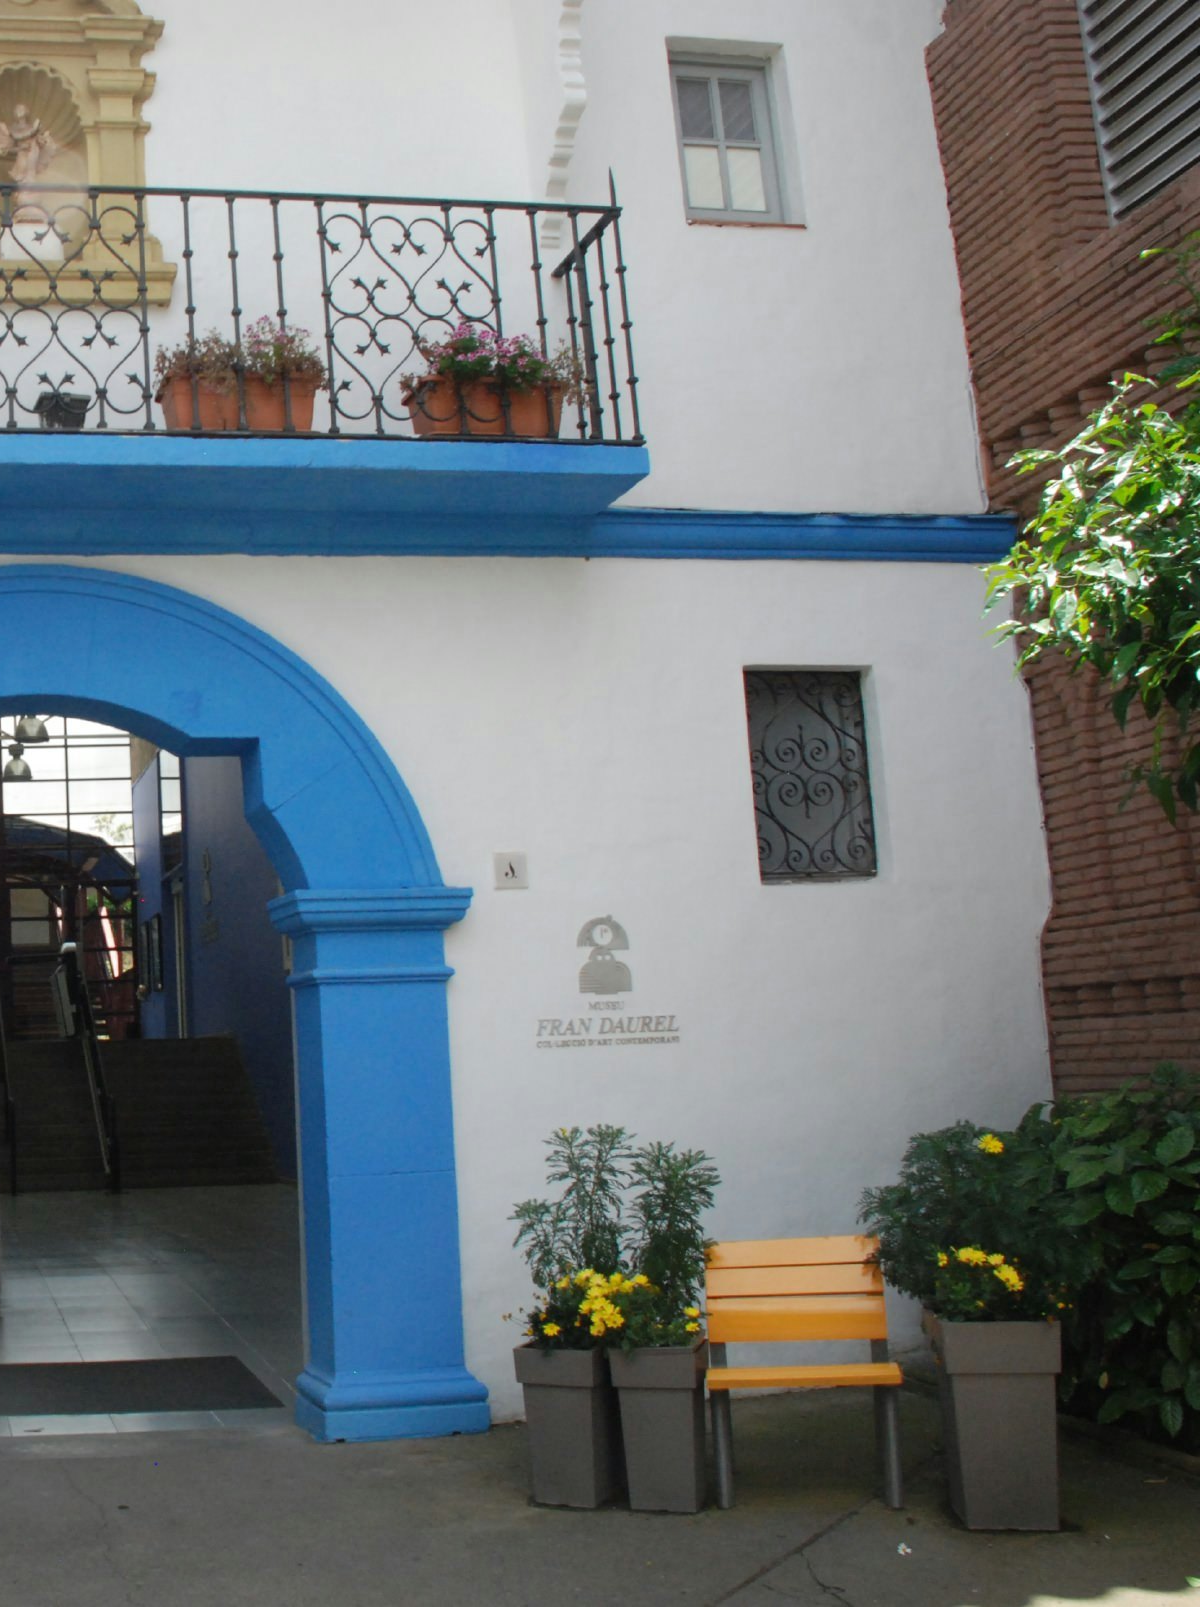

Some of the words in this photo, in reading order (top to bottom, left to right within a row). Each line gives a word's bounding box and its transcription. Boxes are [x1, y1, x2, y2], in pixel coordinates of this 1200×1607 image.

[588, 1001, 624, 1011] MUSEU
[536, 1018, 592, 1037] FRAN
[598, 1015, 680, 1034] DAUREL
